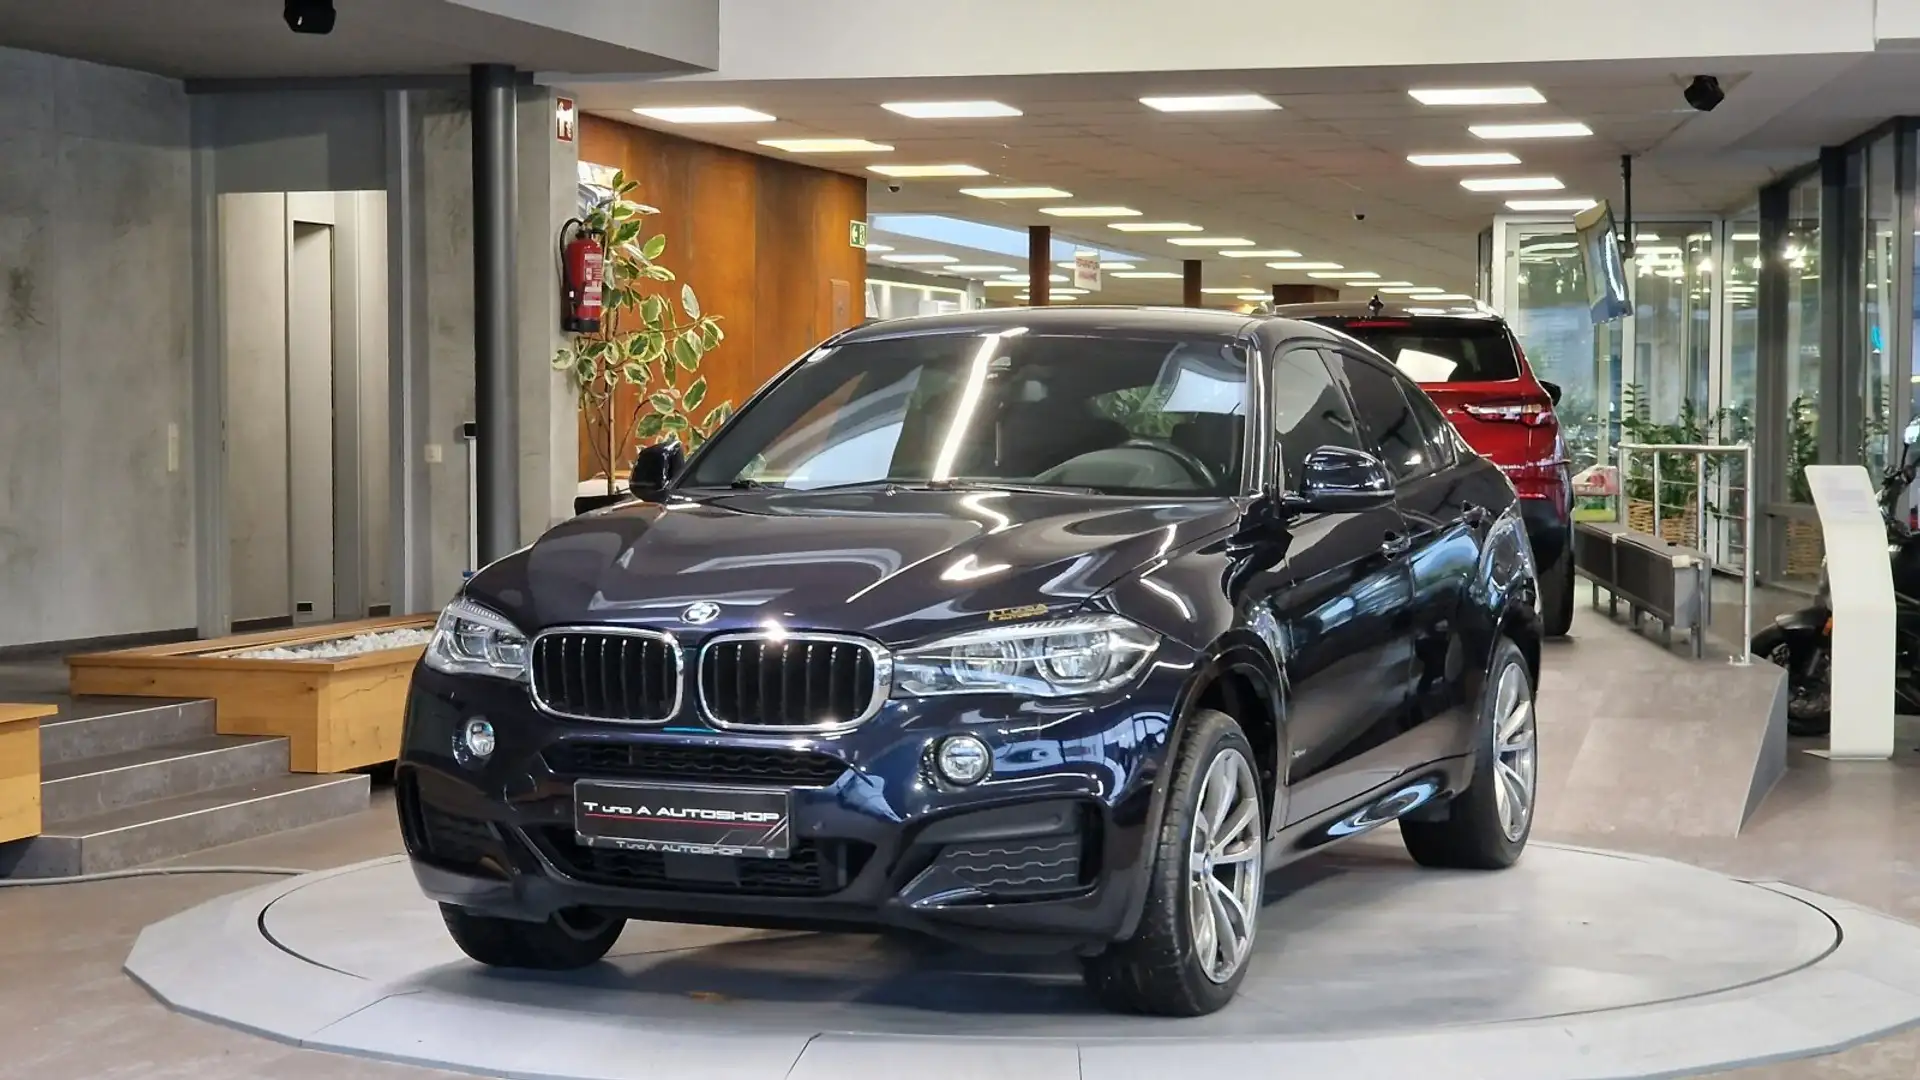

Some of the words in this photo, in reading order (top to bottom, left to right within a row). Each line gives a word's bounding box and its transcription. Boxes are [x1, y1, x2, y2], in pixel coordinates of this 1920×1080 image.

[583, 801, 599, 811] T
[637, 805, 652, 815] A
[656, 807, 780, 821] AUTOSHOP
[661, 844, 743, 855] AUTOSHOP
